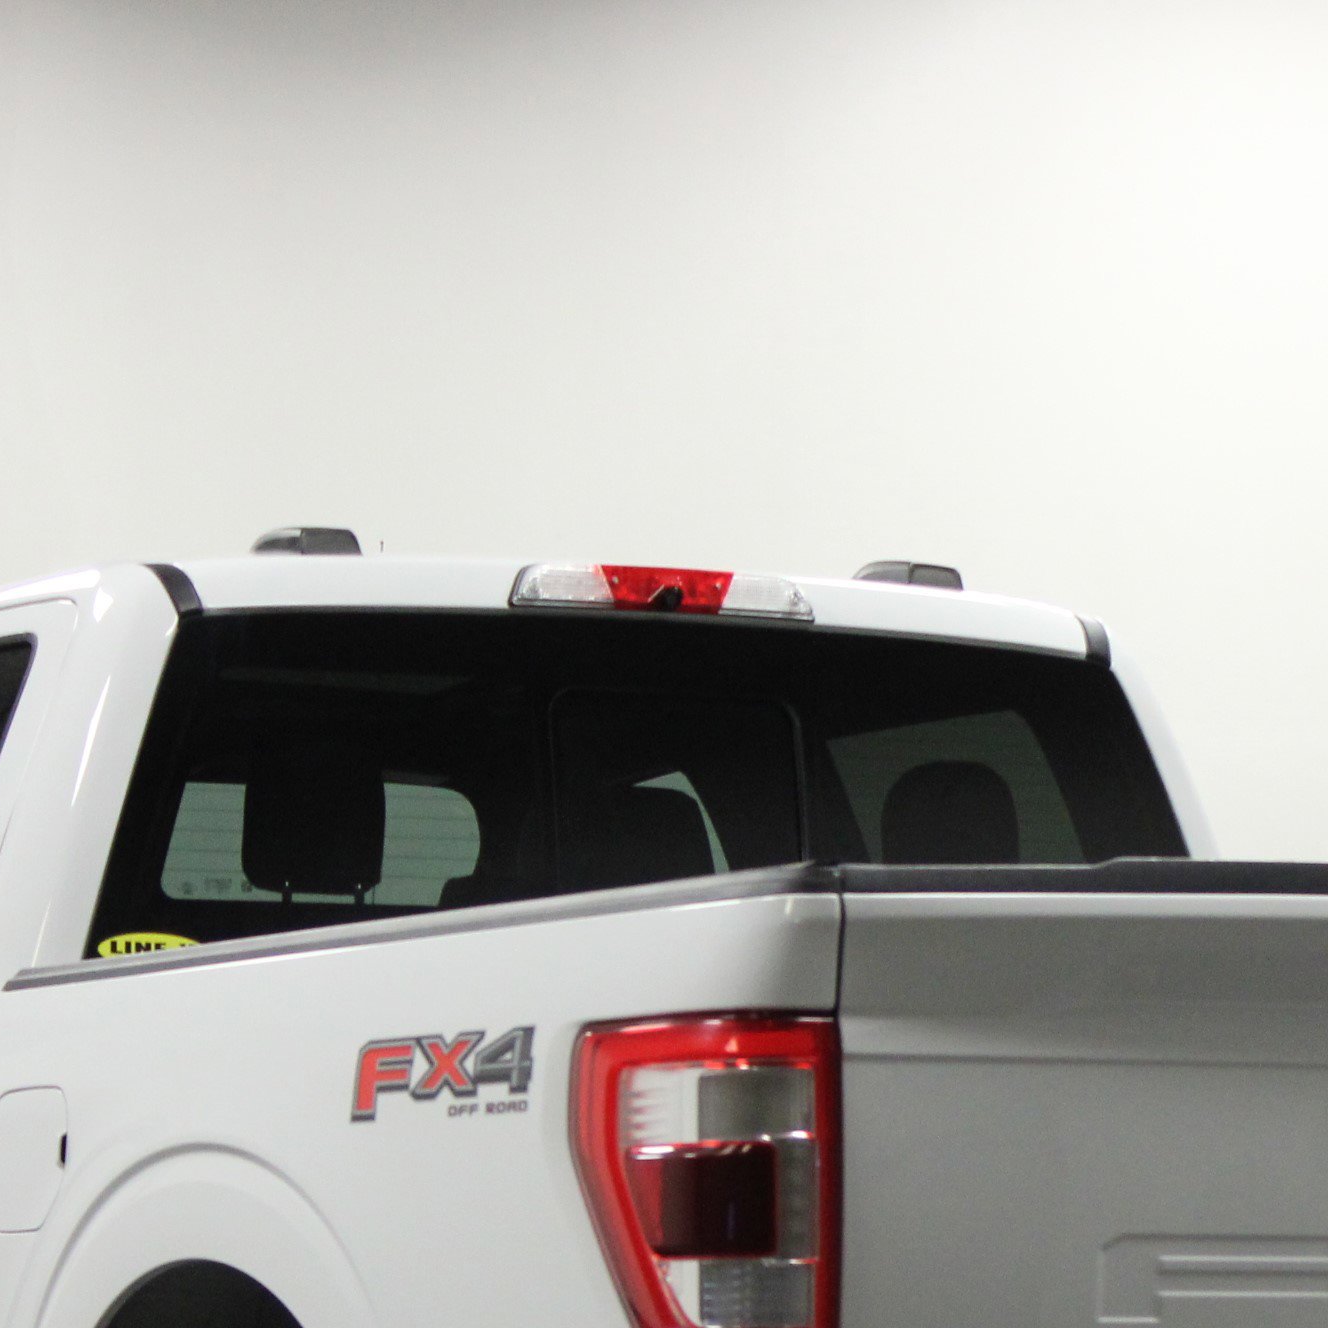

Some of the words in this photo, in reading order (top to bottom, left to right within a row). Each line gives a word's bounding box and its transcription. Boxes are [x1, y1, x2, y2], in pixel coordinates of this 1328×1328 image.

[350, 1024, 536, 1123] FX4
[447, 1102, 478, 1117] OFF
[485, 1100, 529, 1114] ROAD
